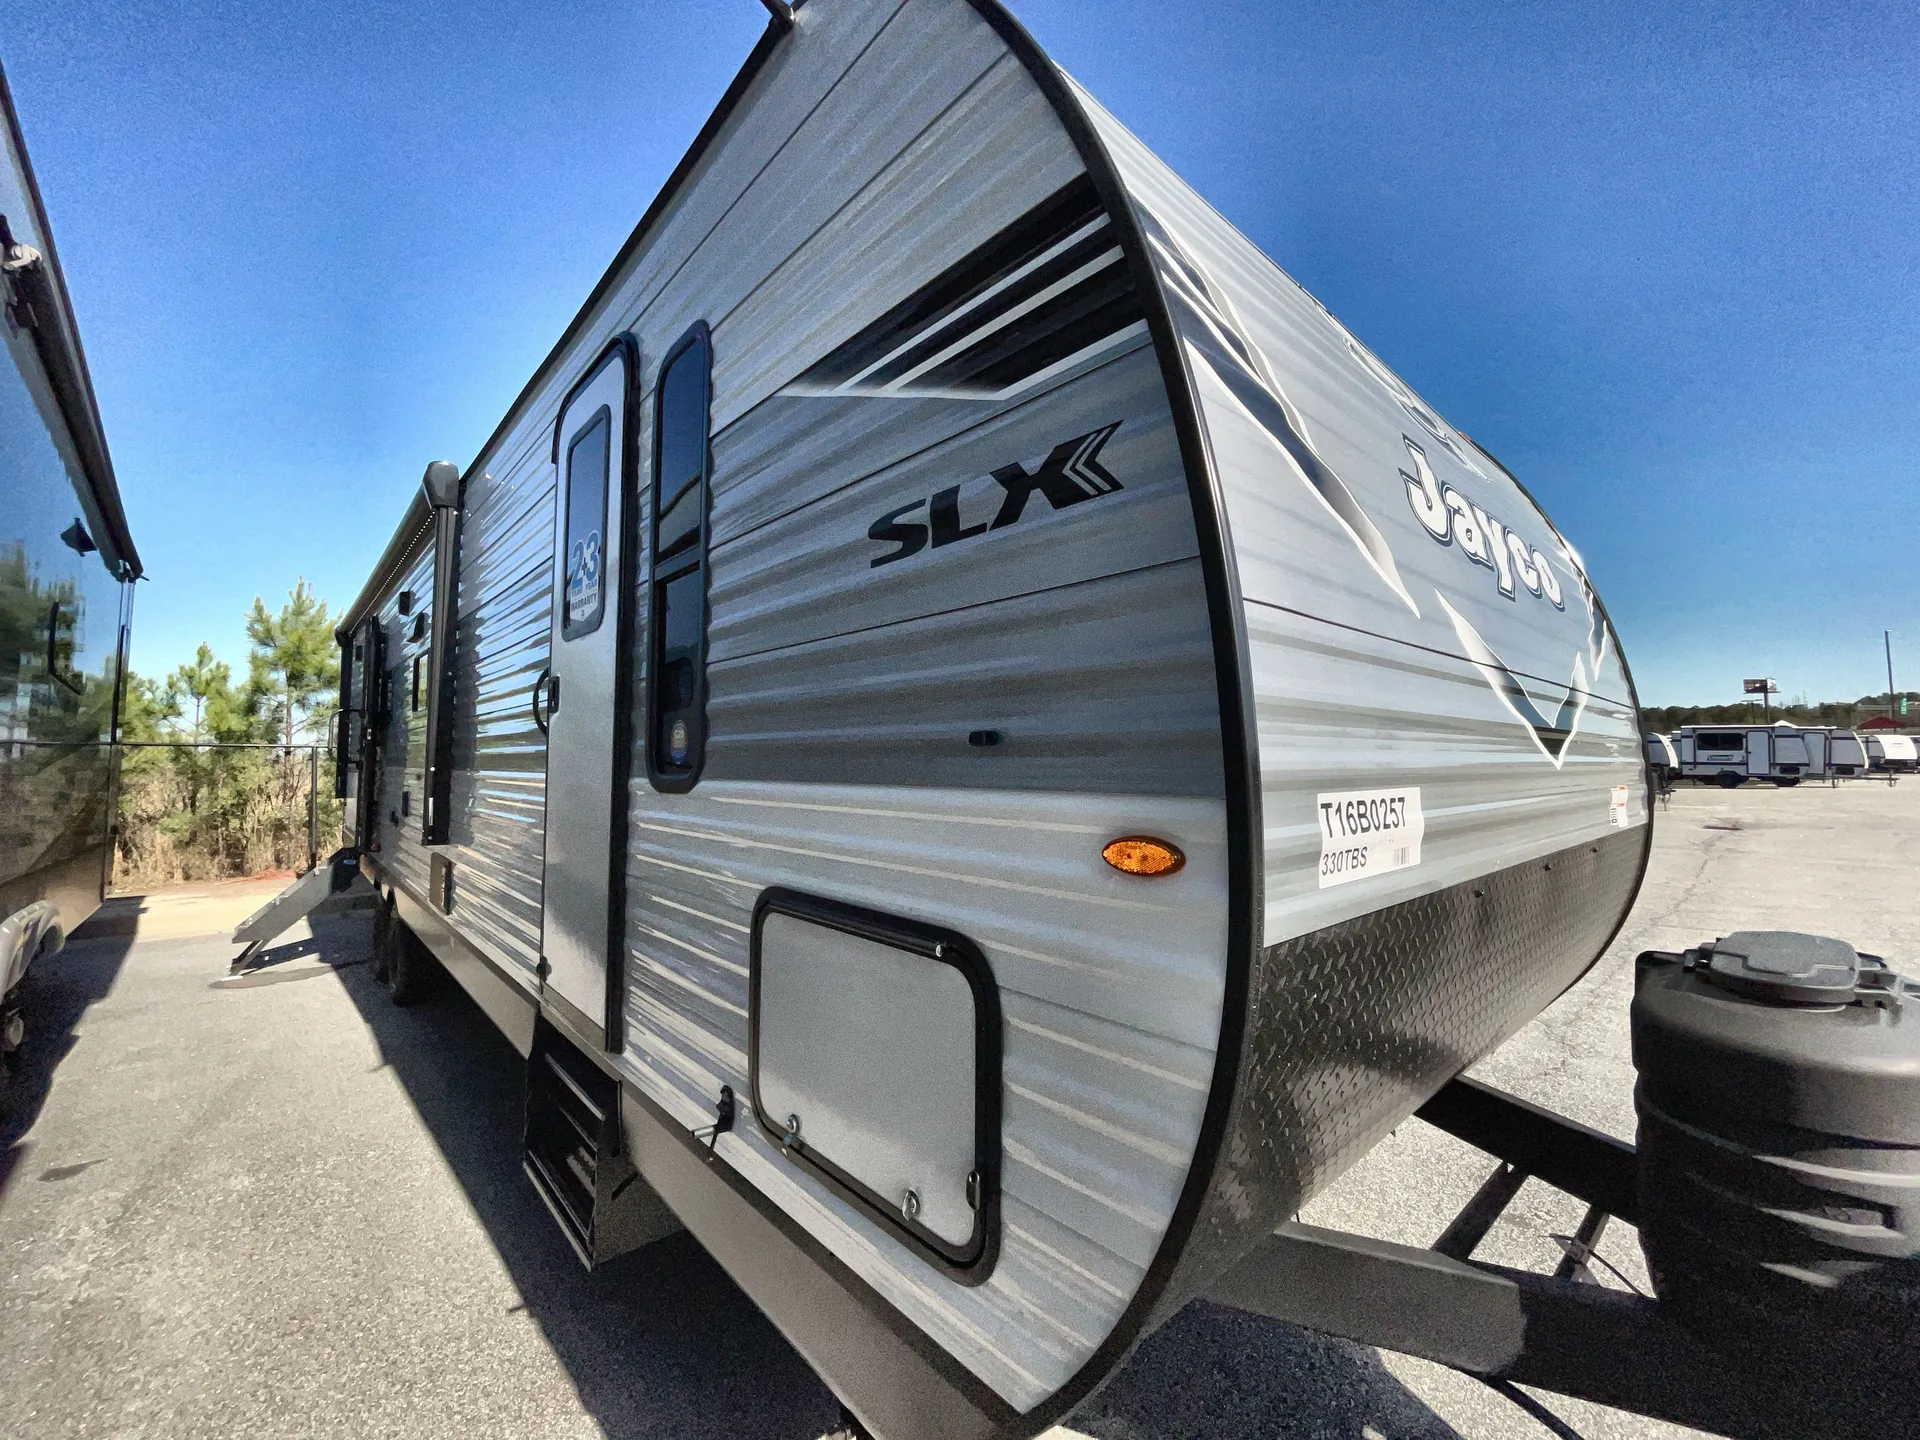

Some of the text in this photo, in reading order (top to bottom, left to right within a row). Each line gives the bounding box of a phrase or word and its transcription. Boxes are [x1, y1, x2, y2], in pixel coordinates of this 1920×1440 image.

[868, 419, 1124, 568] SLX
[1398, 432, 1565, 612] Jayco
[1320, 797, 1406, 838] T16B0257
[1322, 846, 1368, 876] 330TBS
